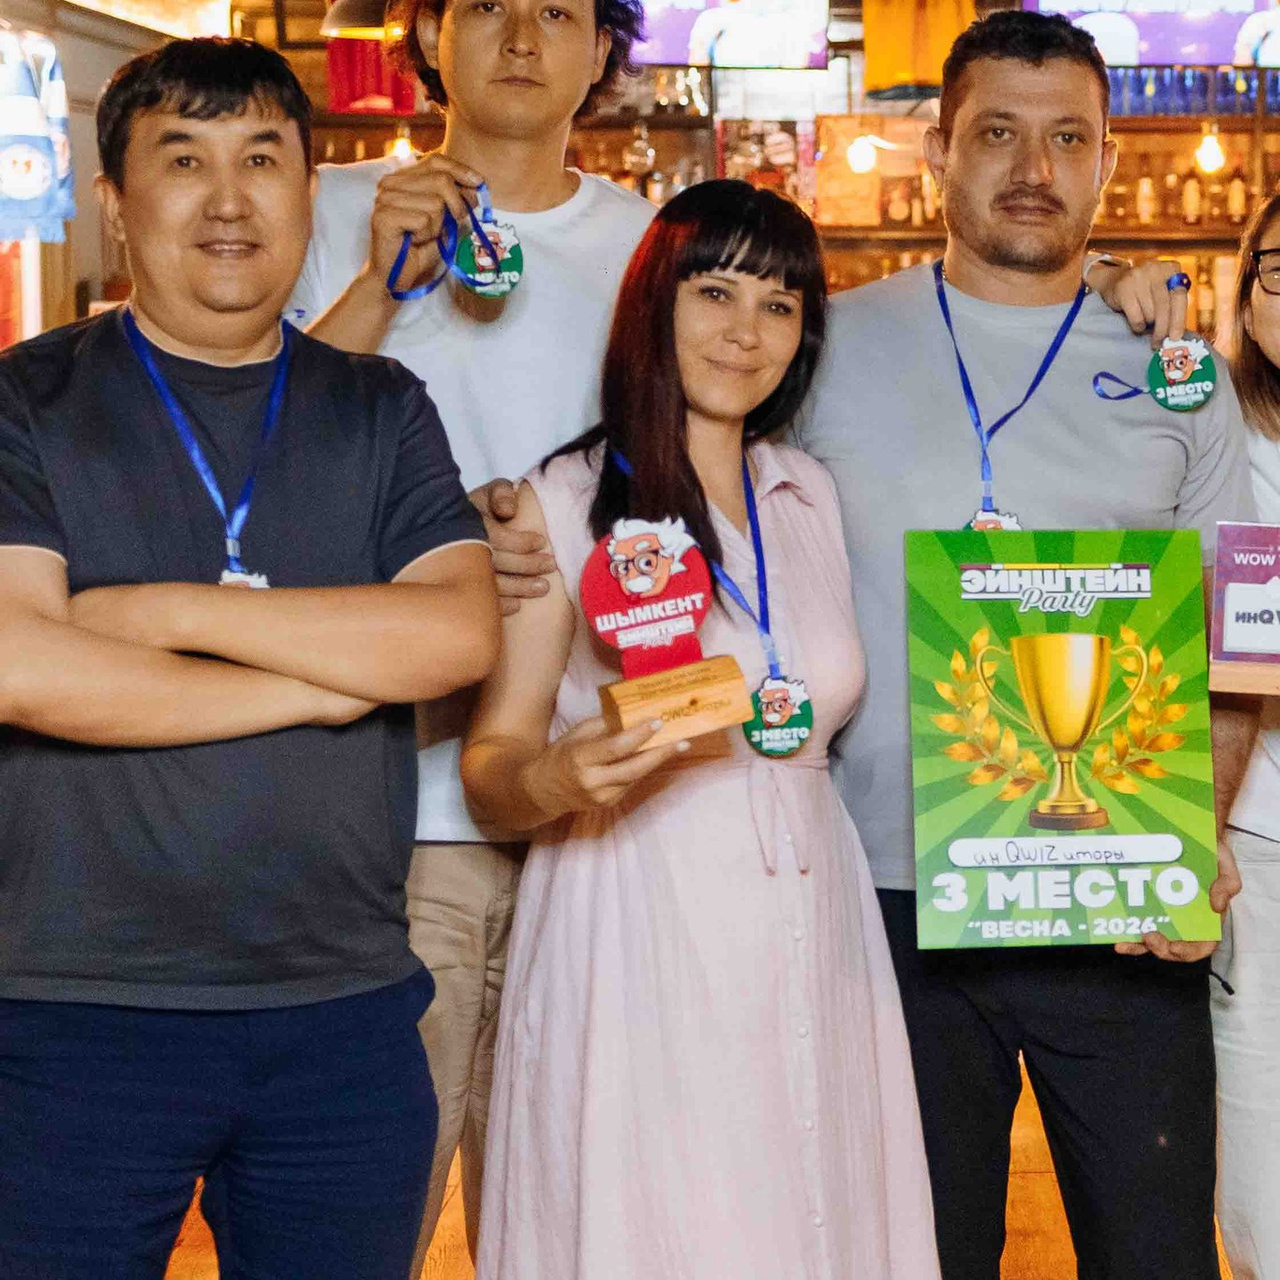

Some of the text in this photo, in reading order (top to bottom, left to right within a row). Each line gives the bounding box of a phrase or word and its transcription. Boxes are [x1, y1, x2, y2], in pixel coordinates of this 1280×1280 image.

[1166, 381, 1213, 397] МЕСТО
[1233, 552, 1275, 566] WOW
[960, 563, 1151, 594] ЭЙНШТЕЙН
[595, 592, 705, 632] ШЫМКЕНТ
[1019, 587, 1099, 617] Party
[762, 727, 810, 741] МЕСТО
[931, 866, 1199, 913] 3 МЕСТО
